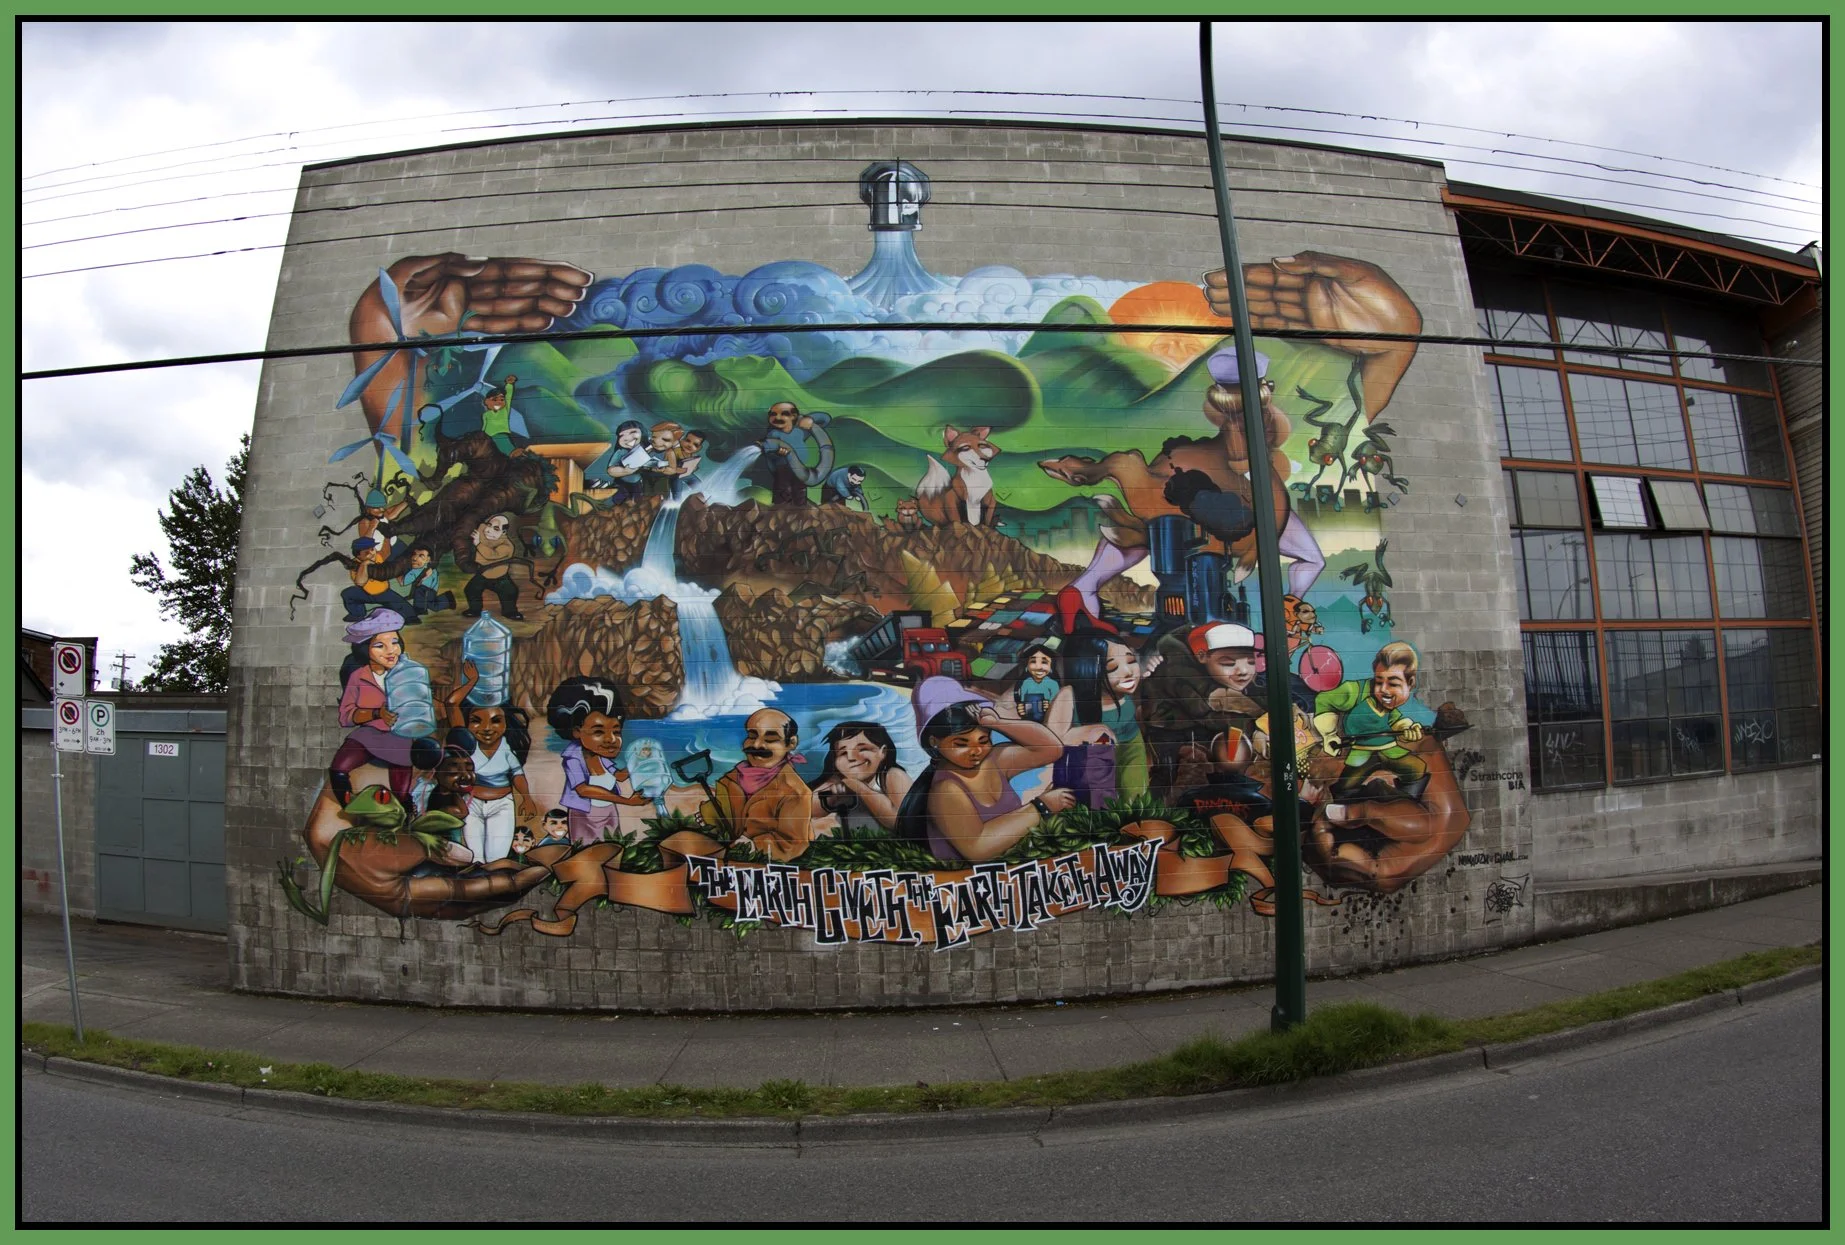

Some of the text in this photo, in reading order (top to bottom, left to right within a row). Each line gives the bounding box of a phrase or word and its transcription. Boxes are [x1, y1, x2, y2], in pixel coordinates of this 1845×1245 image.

[96, 709, 106, 722] P
[154, 744, 174, 755] 1302
[1286, 763, 1291, 771] 4
[1471, 770, 1523, 781] Strathcona
[1287, 782, 1292, 791] 2
[1508, 780, 1525, 790] BIA
[687, 855, 735, 899] THE
[733, 864, 816, 927] EARTH
[896, 872, 938, 912] THE
[932, 863, 1016, 952] EARTH
[1007, 852, 1102, 932] TAKETH
[1091, 837, 1164, 912] AWAY
